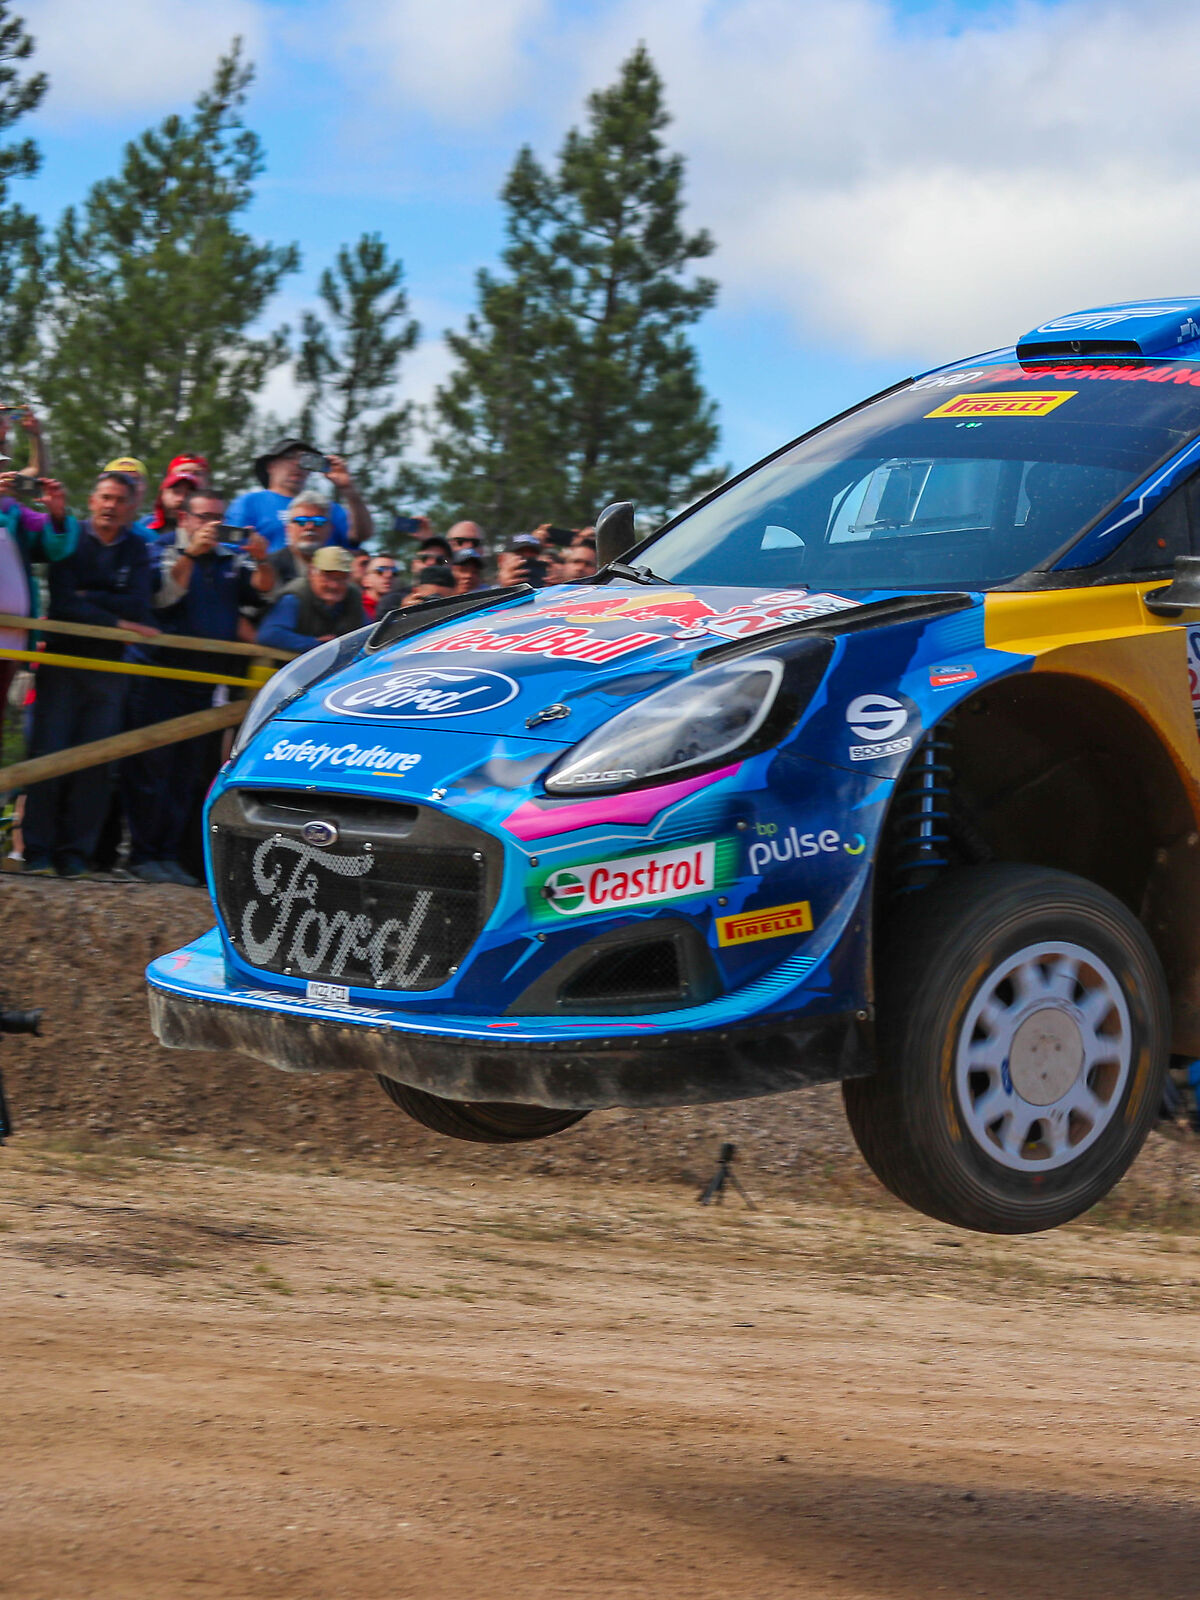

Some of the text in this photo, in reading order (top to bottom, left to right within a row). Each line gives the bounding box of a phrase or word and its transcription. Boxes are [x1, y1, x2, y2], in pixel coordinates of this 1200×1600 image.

[909, 371, 984, 391] ORD
[943, 396, 1057, 413] PIRELLI
[341, 668, 493, 713] Ford
[264, 739, 422, 770] SafetyCulture
[555, 769, 638, 785] LAZER
[755, 820, 778, 837] bp
[749, 827, 842, 875] pulse
[588, 851, 706, 906] Castrol
[241, 836, 434, 988] Ford
[724, 905, 806, 940] PIRELLI
